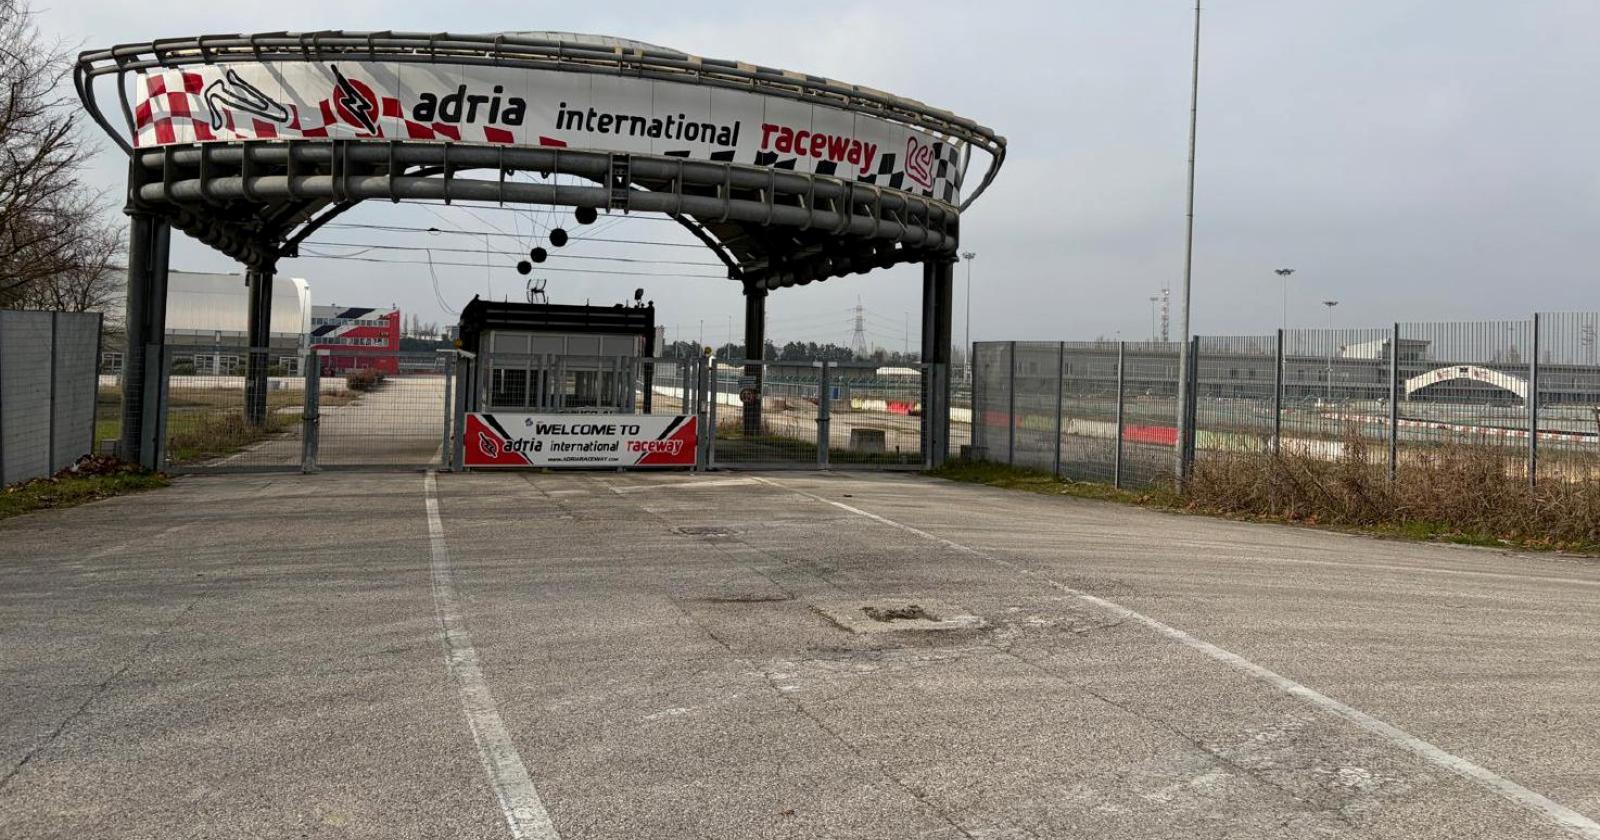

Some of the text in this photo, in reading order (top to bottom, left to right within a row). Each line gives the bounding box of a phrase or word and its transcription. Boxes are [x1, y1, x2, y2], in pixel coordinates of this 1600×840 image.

[413, 85, 877, 174] adria international raceway
[536, 424, 640, 435] WELCOME TO
[503, 438, 682, 455] adria international raceway
